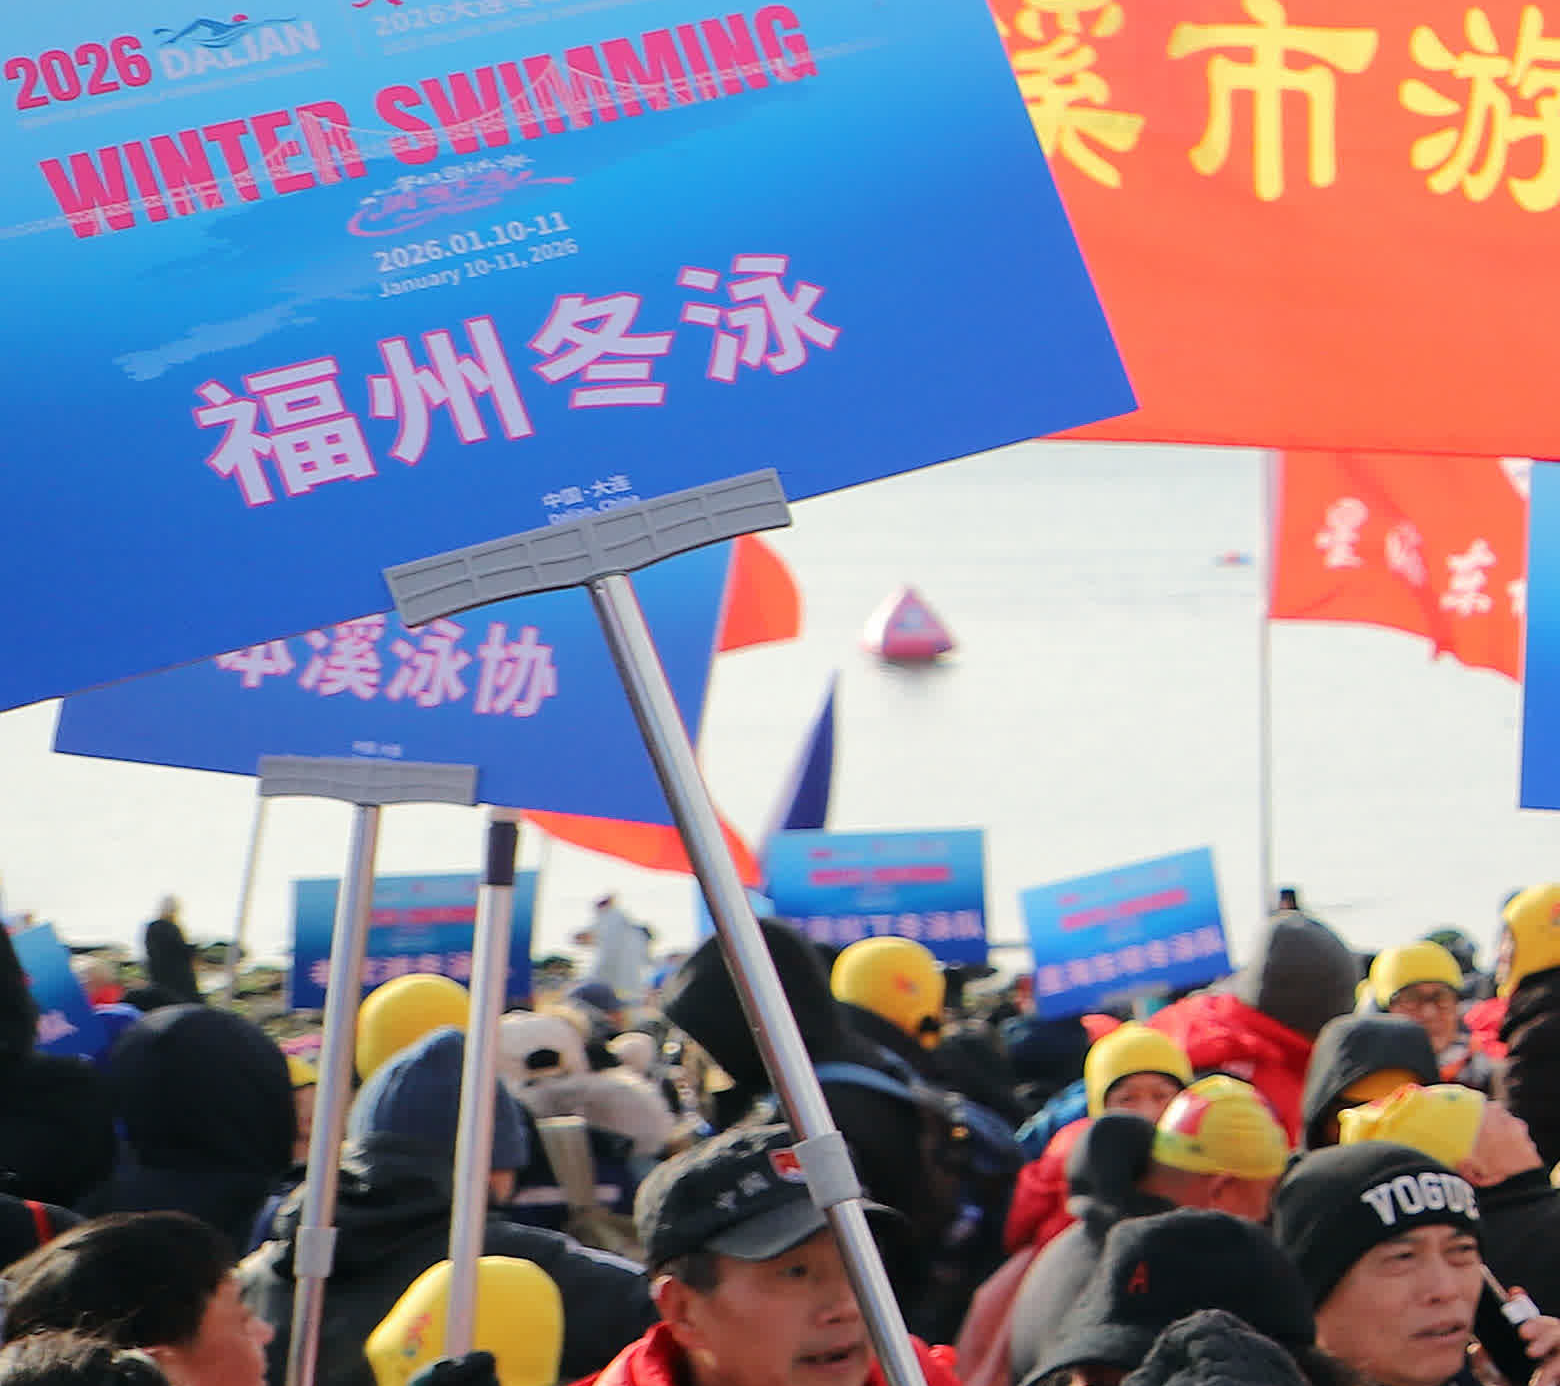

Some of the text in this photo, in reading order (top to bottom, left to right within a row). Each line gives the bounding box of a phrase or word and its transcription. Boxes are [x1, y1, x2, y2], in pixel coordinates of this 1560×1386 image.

[4, 35, 152, 111] 2026
[157, 20, 322, 80] DALIAN
[38, 97, 367, 241] WINTER
[374, 4, 819, 168] SWIMMING
[372, 211, 571, 273] 2026.01.10-11
[377, 264, 461, 299] January
[527, 238, 579, 264] 2026
[192, 251, 841, 509] 福州冬泳
